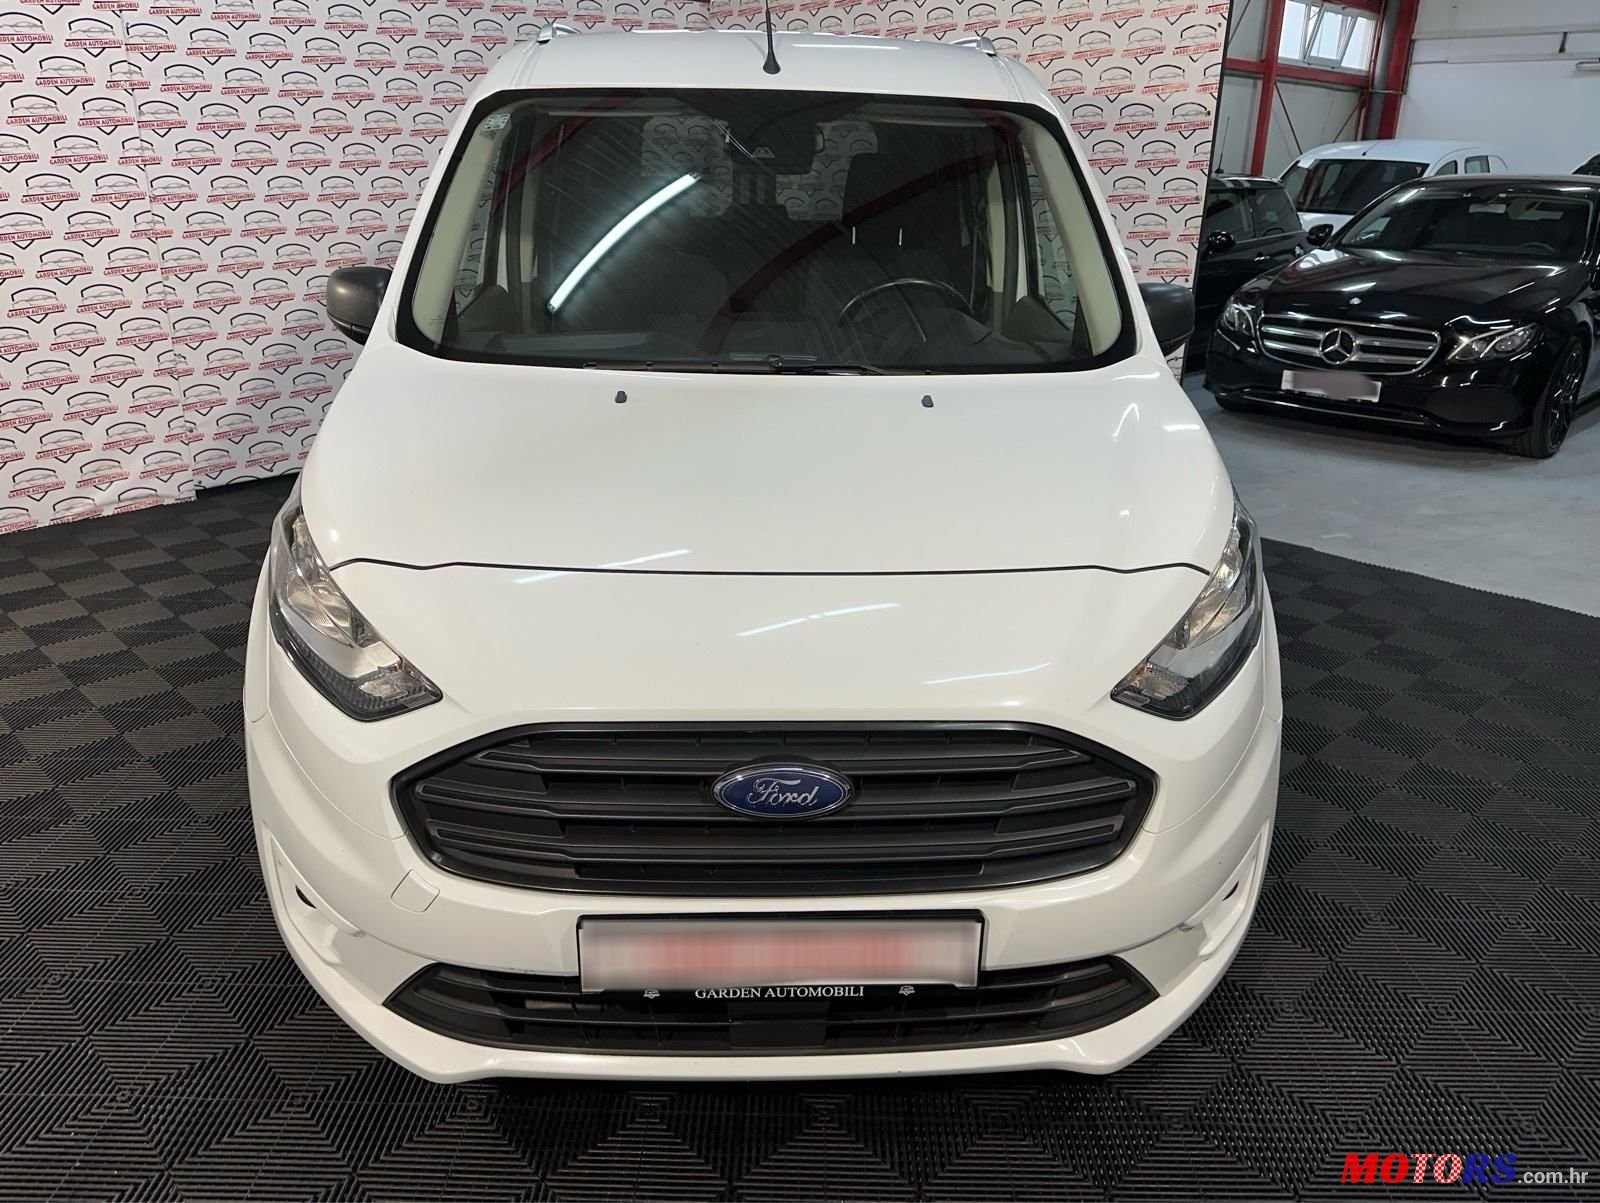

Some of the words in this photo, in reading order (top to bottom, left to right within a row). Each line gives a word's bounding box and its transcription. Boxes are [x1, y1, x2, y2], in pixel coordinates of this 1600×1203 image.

[35, 78, 59, 87] GARDEN
[61, 76, 96, 85] AUTOMOBILI
[6, 117, 31, 125] GARDEN
[32, 114, 67, 123] AUTOMOBILI
[102, 117, 135, 125] AUTOMOBILI
[2, 154, 39, 162] AUTOMOBILI
[50, 157, 72, 165] GARDEN
[74, 154, 107, 163] AUTOMOBILI
[193, 157, 223, 165] AUTOMOBILI
[21, 195, 45, 204] GARDEN
[46, 191, 80, 201] AUTOMOBILI
[91, 195, 113, 203] GARDEN
[114, 191, 145, 200] AUTOMOBILI
[17, 230, 53, 238] AUTOMOBILI
[64, 232, 86, 241] GARDEN
[88, 228, 120, 238] AUTOMOBILI
[36, 270, 58, 279] GARDEN
[60, 265, 92, 276] AUTOMOBILI
[104, 267, 126, 276] GARDEN
[127, 262, 158, 273] AUTOMOBILI
[7, 309, 30, 318] GARDEN
[31, 303, 65, 314] AUTOMOBILI
[77, 304, 99, 314] GARDEN
[100, 299, 132, 310] AUTOMOBILI
[4, 342, 39, 352] AUTOMOBILI
[50, 342, 72, 352] GARDEN
[74, 336, 106, 348] AUTOMOBILI
[22, 380, 45, 391] GARDEN
[46, 374, 80, 386] AUTOMOBILI
[17, 413, 52, 424] AUTOMOBILI
[63, 411, 85, 422] GARDEN
[86, 404, 118, 417] AUTOMOBILI
[36, 449, 58, 461] GARDEN
[60, 442, 92, 455] AUTOMOBILI
[8, 487, 31, 498] GARDEN
[32, 480, 65, 493] AUTOMOBILI
[746, 778, 820, 806] Ford
[695, 988, 762, 999] GARDEN
[764, 986, 864, 998] AUTOMOBILI
